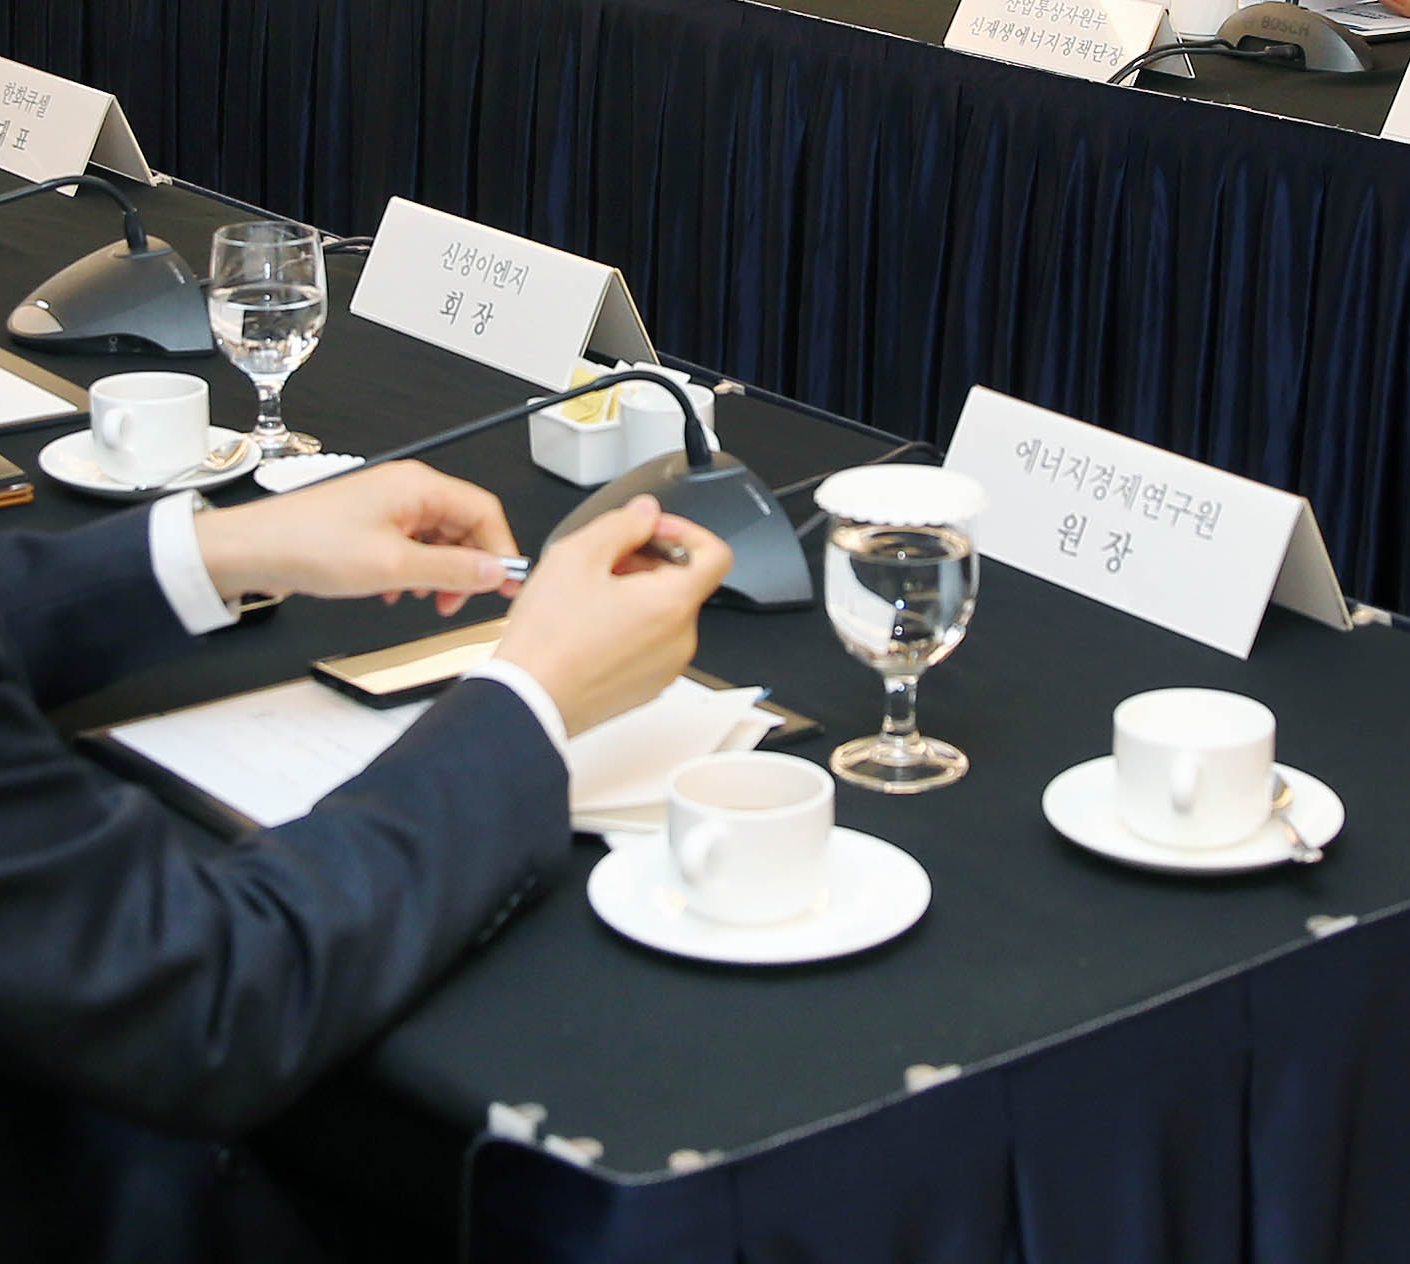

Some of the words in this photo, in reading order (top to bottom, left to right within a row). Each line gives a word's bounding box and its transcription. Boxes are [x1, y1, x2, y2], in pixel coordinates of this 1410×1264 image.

[969, 16, 1125, 67] 신재생에너지정책단장
[1262, 16, 1310, 36] BOSCH
[440, 242, 529, 296] 신성이엔지
[1016, 439, 1223, 540] 에너지경제연구원
